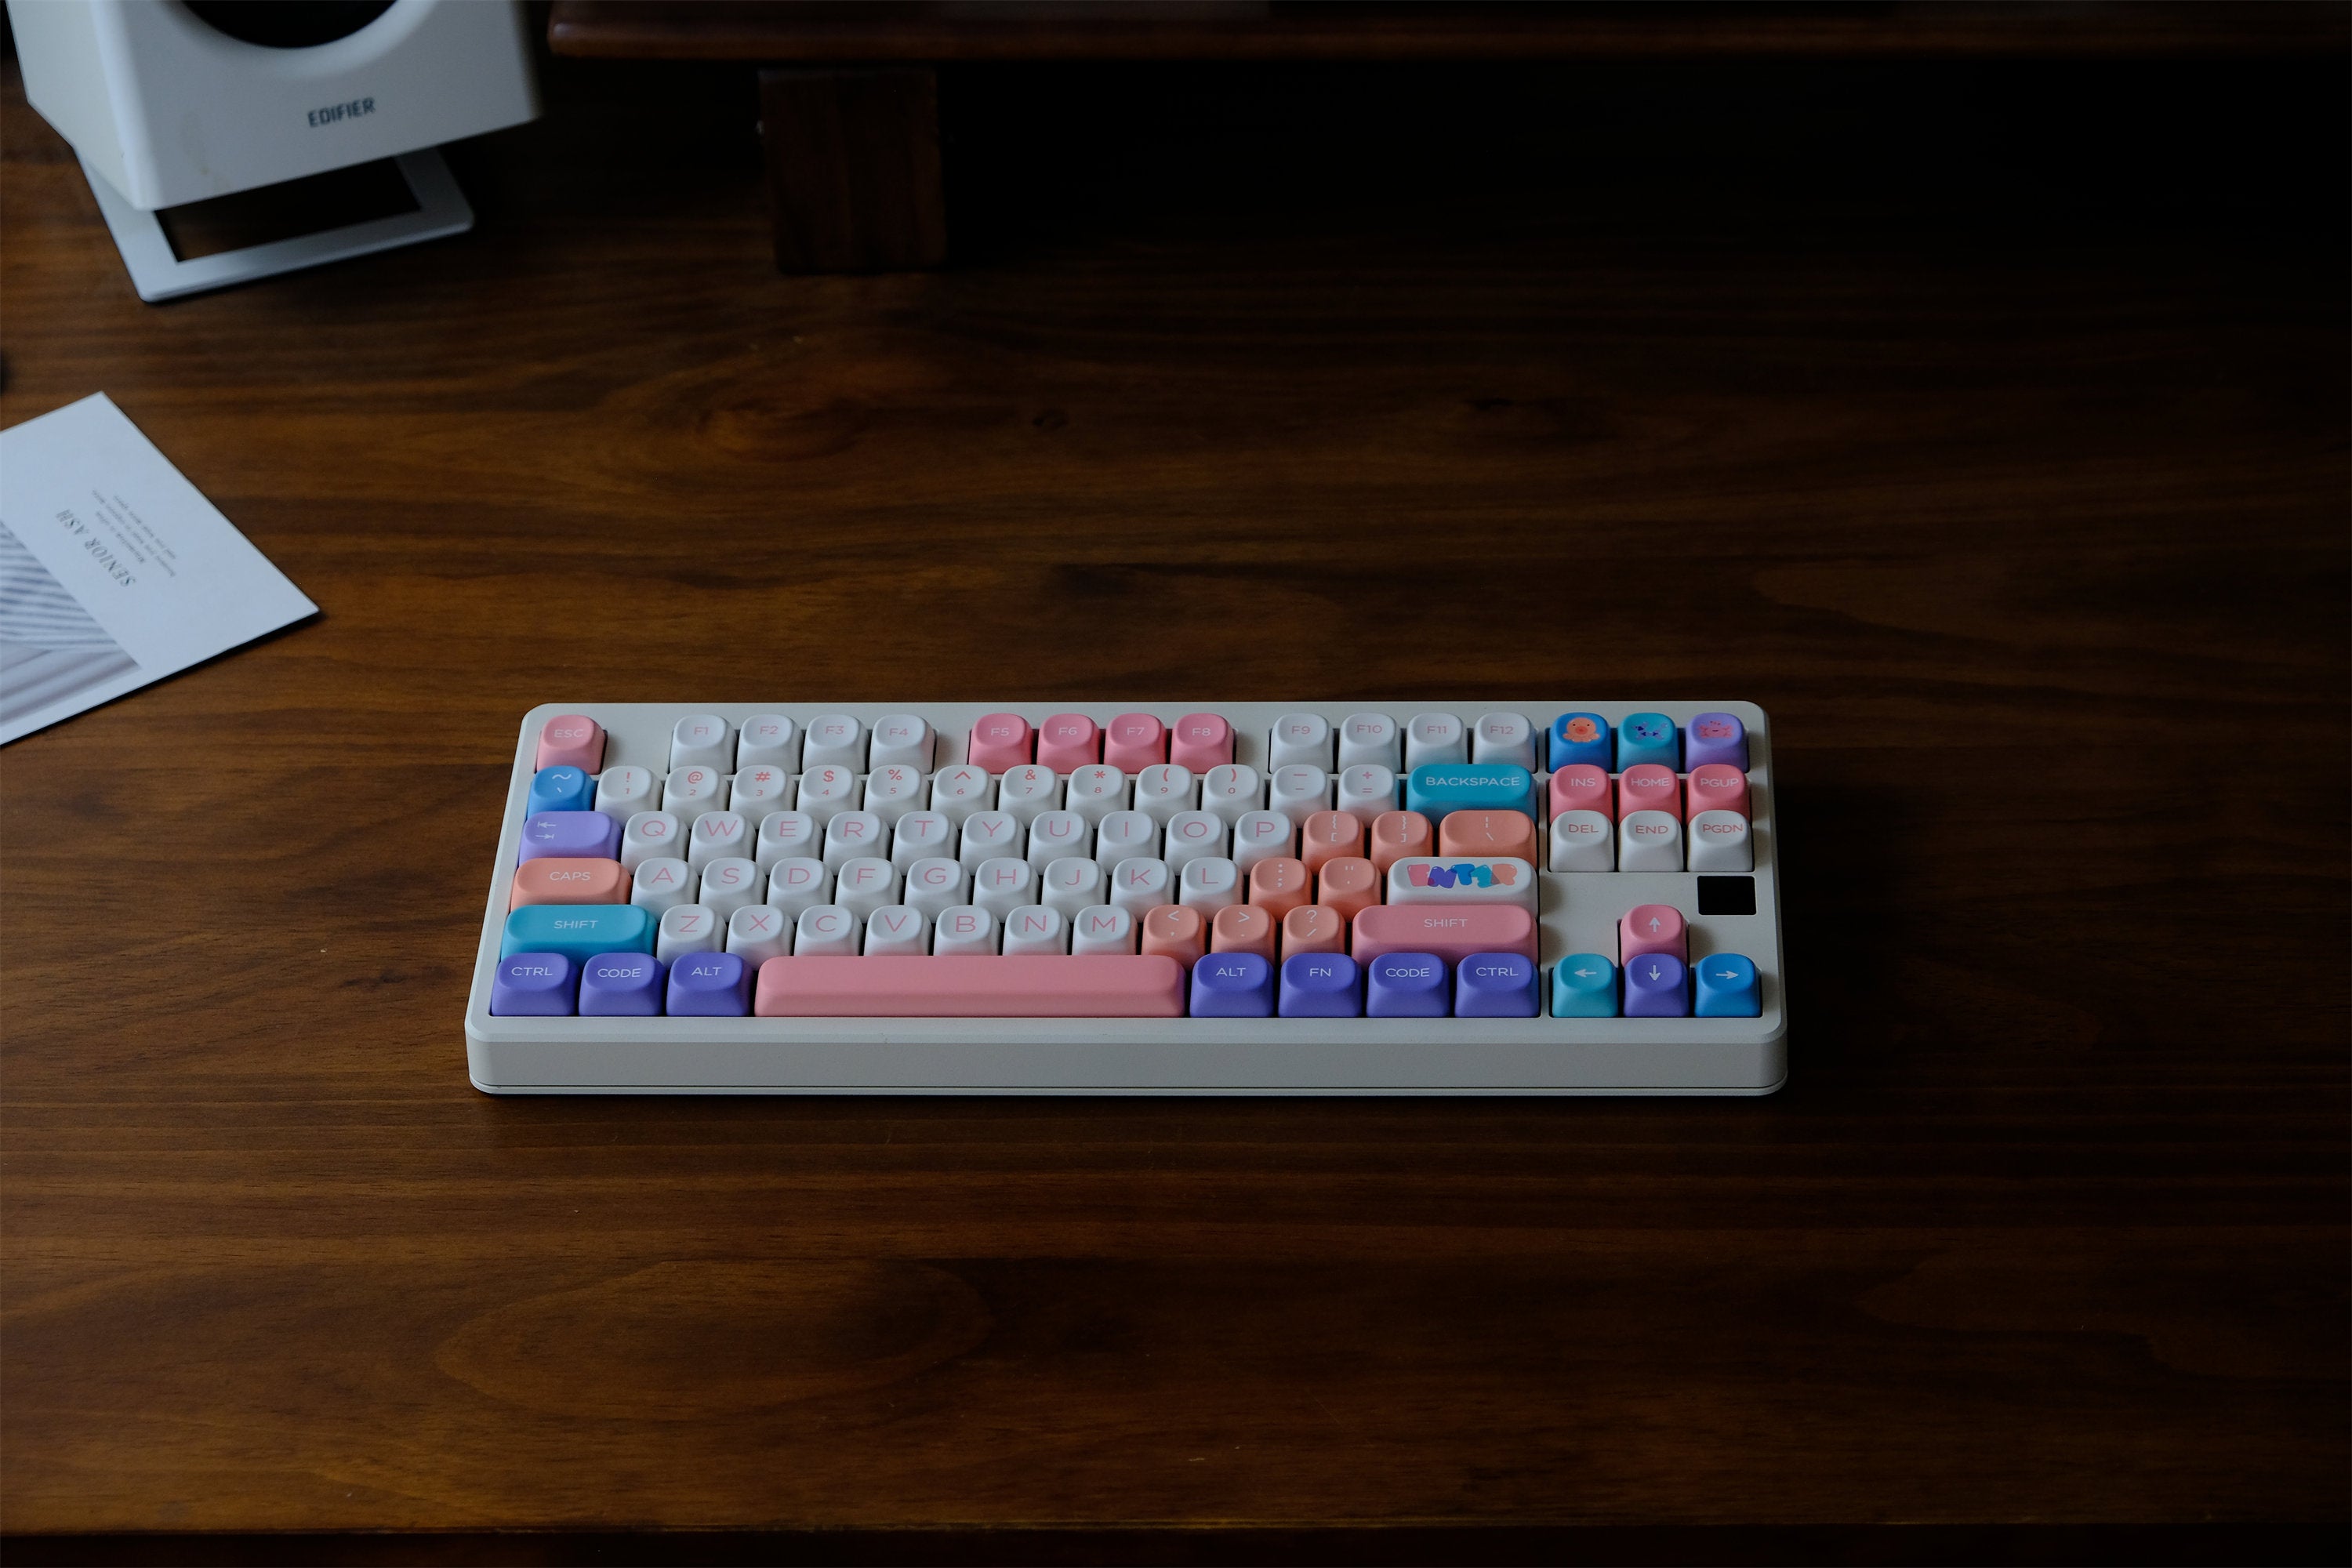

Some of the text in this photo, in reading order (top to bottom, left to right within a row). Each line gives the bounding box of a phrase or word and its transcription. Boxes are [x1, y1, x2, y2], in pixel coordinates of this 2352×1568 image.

[307, 96, 376, 128] EDIFIER
[55, 509, 91, 535] ASH
[84, 537, 136, 586] SENIOR
[554, 728, 584, 739] ESC
[694, 727, 709, 735] F1
[759, 725, 779, 735] F2
[826, 725, 844, 735] F3
[889, 728, 909, 737] F4
[991, 728, 1010, 736] F5
[1058, 727, 1078, 736] F6
[1127, 727, 1145, 736] F7
[1192, 728, 1211, 736] F8
[1291, 725, 1311, 735] F9
[1356, 724, 1383, 734] F10
[1426, 725, 1447, 735] F11
[1490, 725, 1513, 735] F12
[626, 771, 630, 782] !
[687, 771, 703, 784] @
[754, 771, 771, 782] #
[822, 769, 835, 783] $
[887, 768, 903, 781] %
[954, 771, 971, 780] ^
[1025, 769, 1036, 781] &
[1163, 768, 1169, 782] (
[1230, 768, 1236, 782] )
[1362, 771, 1373, 779] +
[1425, 776, 1521, 786] BACKSPACE
[1570, 778, 1596, 787] INS
[1631, 777, 1670, 787] HOME
[1700, 778, 1740, 788] PGUP
[641, 820, 666, 837] Q
[705, 819, 738, 836] W
[779, 821, 798, 837] E
[843, 821, 865, 838] R
[913, 820, 935, 837] T
[982, 821, 1004, 837] Y
[1049, 820, 1070, 837] U
[1124, 821, 1129, 838] I
[1182, 821, 1208, 838] O
[1256, 821, 1276, 838] P
[1568, 823, 1599, 833] DEL
[1635, 824, 1668, 835] END
[1702, 823, 1744, 833] PGDN
[549, 871, 591, 881] CAPS
[651, 867, 674, 884] A
[721, 867, 740, 884] S
[788, 867, 811, 884] D
[856, 868, 876, 884] F
[924, 867, 947, 884] G
[996, 869, 1017, 885] H
[1065, 869, 1081, 886] J
[1130, 868, 1151, 886] K
[1202, 867, 1219, 884] L
[1406, 863, 1517, 888] ENTER
[1167, 910, 1180, 922] <
[1238, 911, 1250, 923] >
[1305, 909, 1318, 923] ?
[554, 920, 599, 929] SHIFT
[679, 915, 701, 933] Z
[748, 914, 771, 931] X
[815, 915, 837, 932] C
[884, 915, 907, 933] V
[955, 915, 977, 933] B
[1025, 915, 1047, 933] N
[1091, 916, 1116, 932] M
[1423, 918, 1468, 928] SHIFT
[1306, 928, 1317, 937] /
[511, 967, 554, 976] CTRL
[597, 967, 641, 978] CODE
[691, 967, 722, 976] ALT
[1216, 967, 1247, 977] ALT
[1309, 967, 1331, 977] FN
[1385, 967, 1430, 978] CODE
[1475, 967, 1519, 977] CTRL
